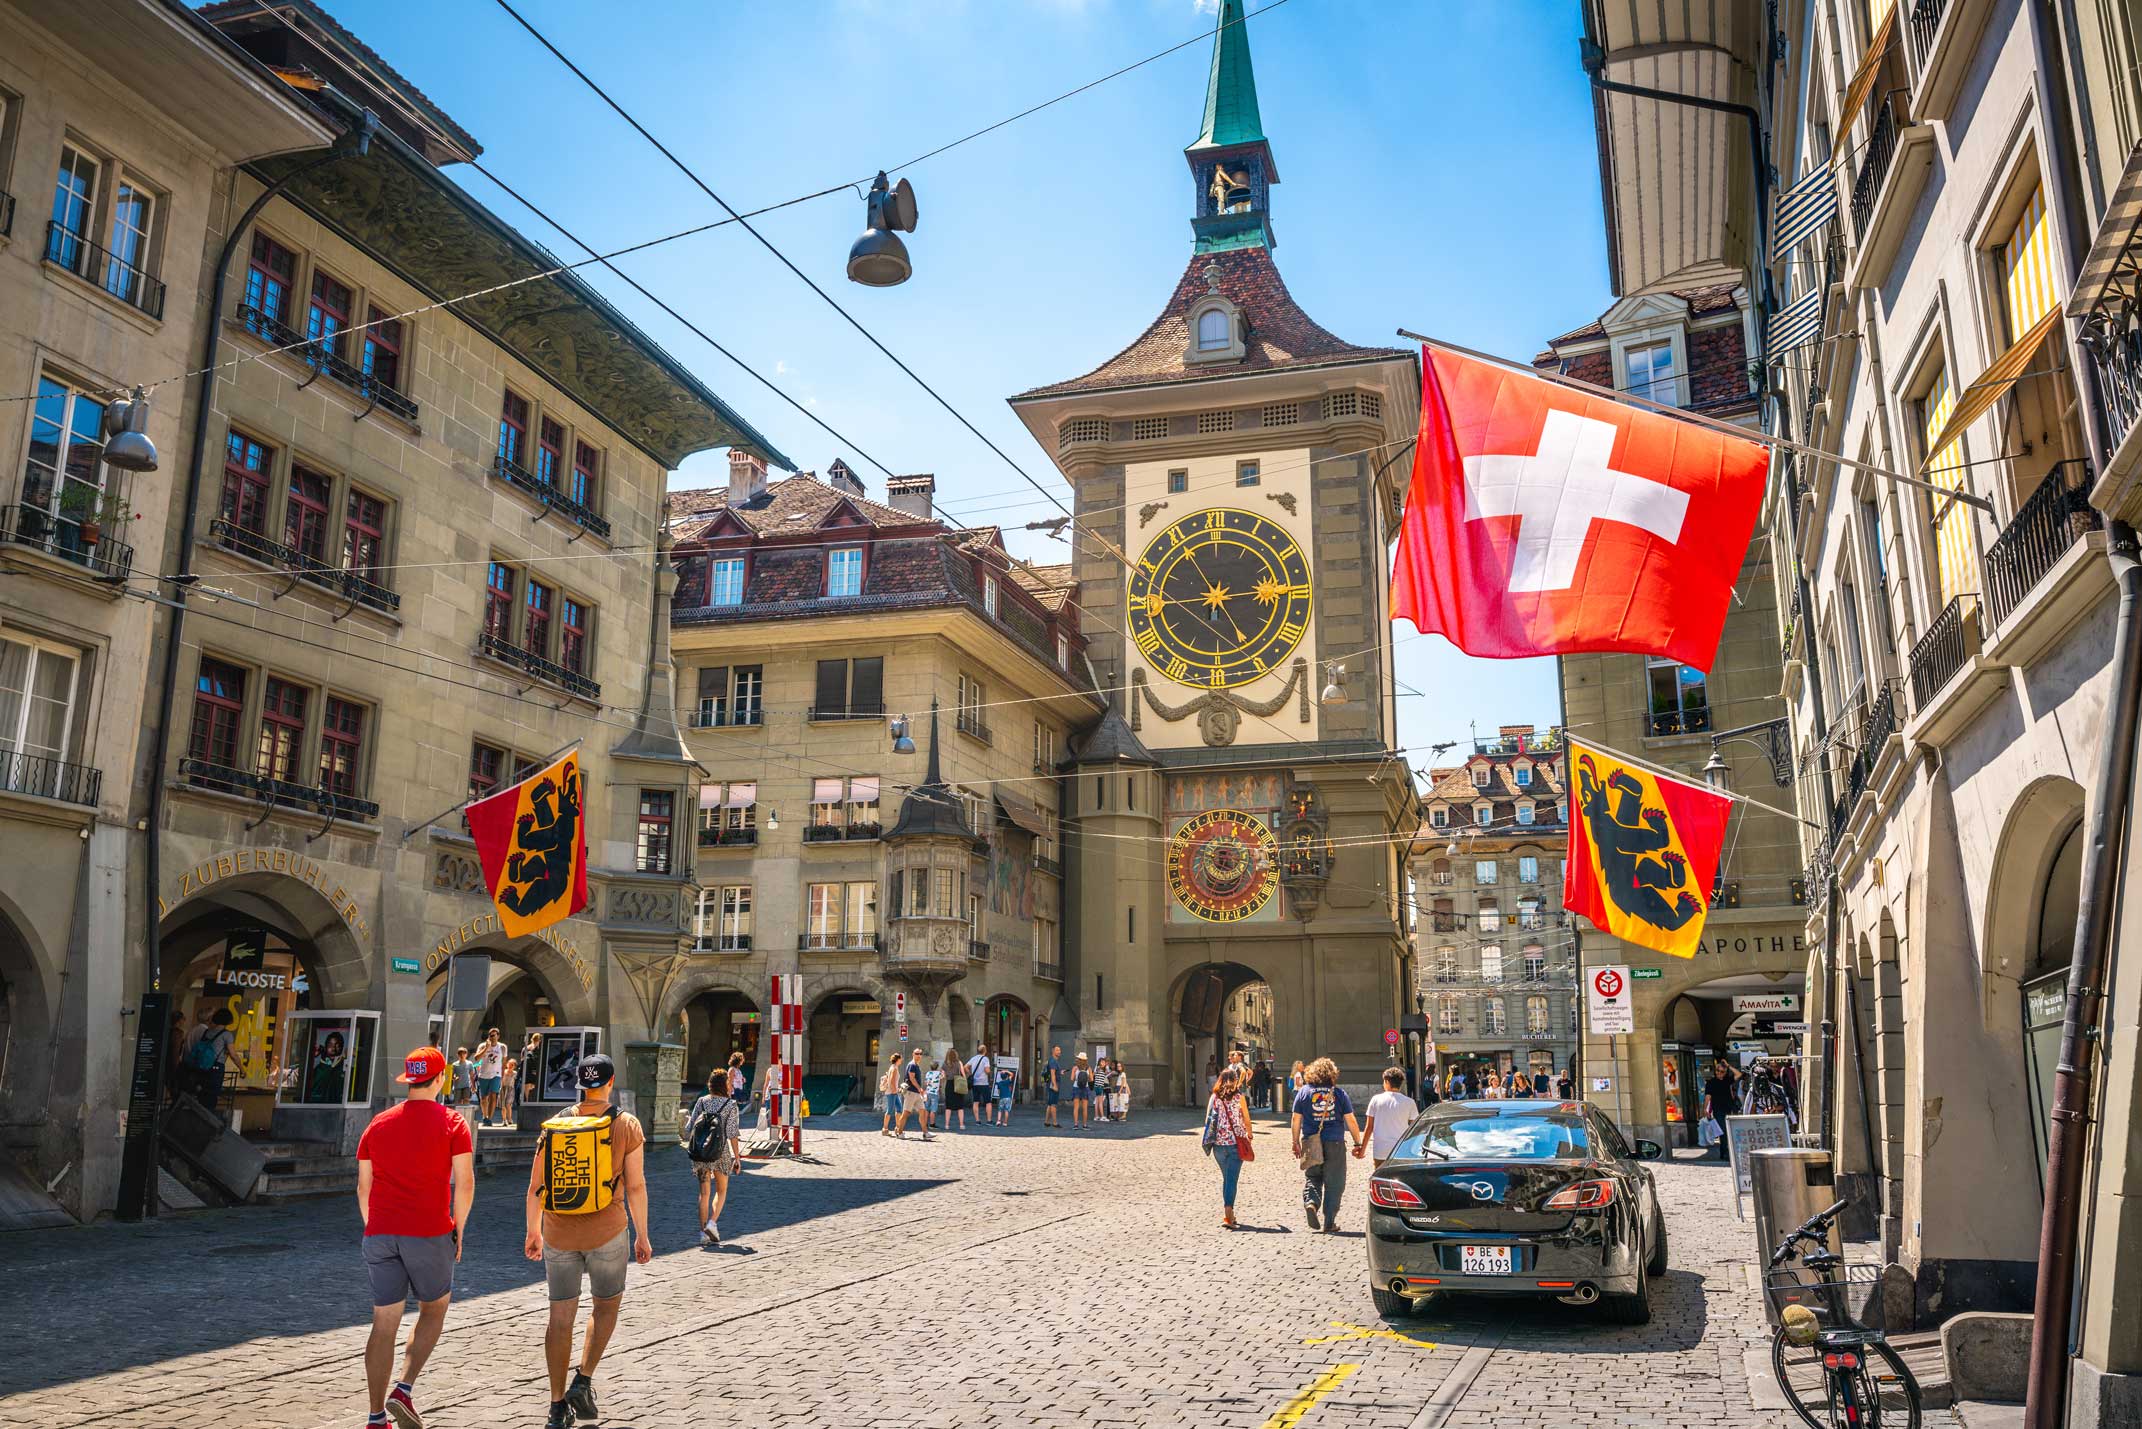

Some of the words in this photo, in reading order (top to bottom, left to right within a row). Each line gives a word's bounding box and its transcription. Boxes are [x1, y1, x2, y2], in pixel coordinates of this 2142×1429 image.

[216, 969, 286, 990] LACOSTE
[225, 994, 276, 1051] SALE
[553, 1150, 566, 1186] FACE
[565, 1135, 578, 1187] NORTH
[577, 1156, 591, 1185] THE
[1464, 1259, 1485, 1272] 126
[1488, 1259, 1510, 1272] 193
[1480, 1247, 1492, 1257] BE
